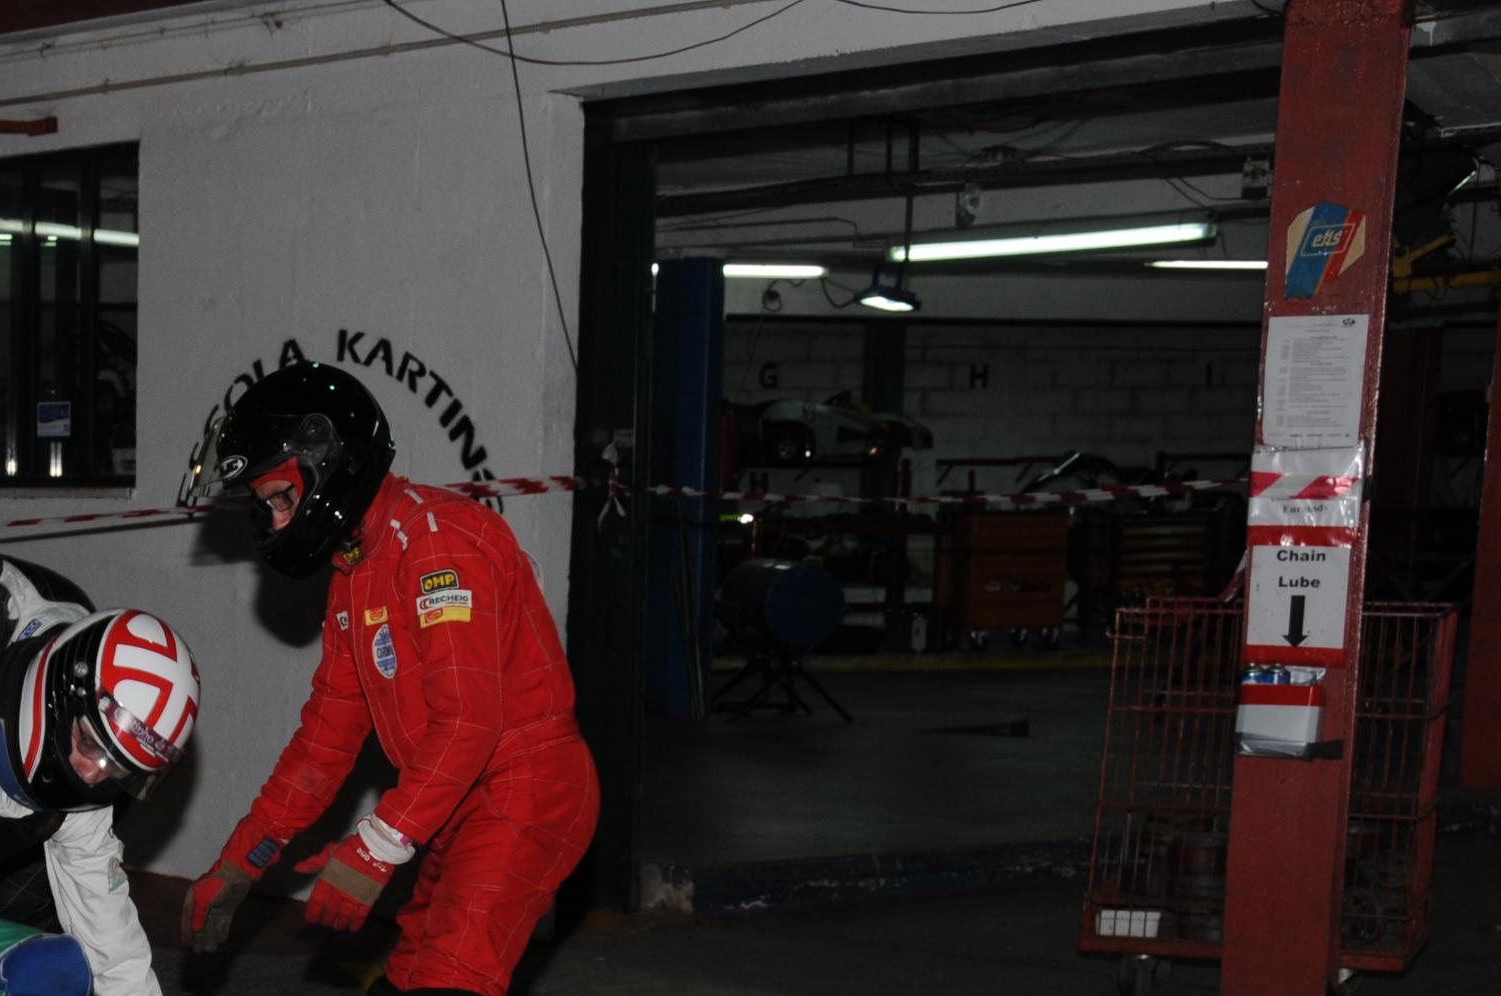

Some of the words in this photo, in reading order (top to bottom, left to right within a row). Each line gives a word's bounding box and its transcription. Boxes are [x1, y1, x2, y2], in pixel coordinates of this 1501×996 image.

[759, 363, 778, 388] G
[969, 364, 989, 388] H
[1276, 550, 1327, 562] Chain
[423, 573, 455, 592] OMP
[1278, 576, 1321, 588] Lube
